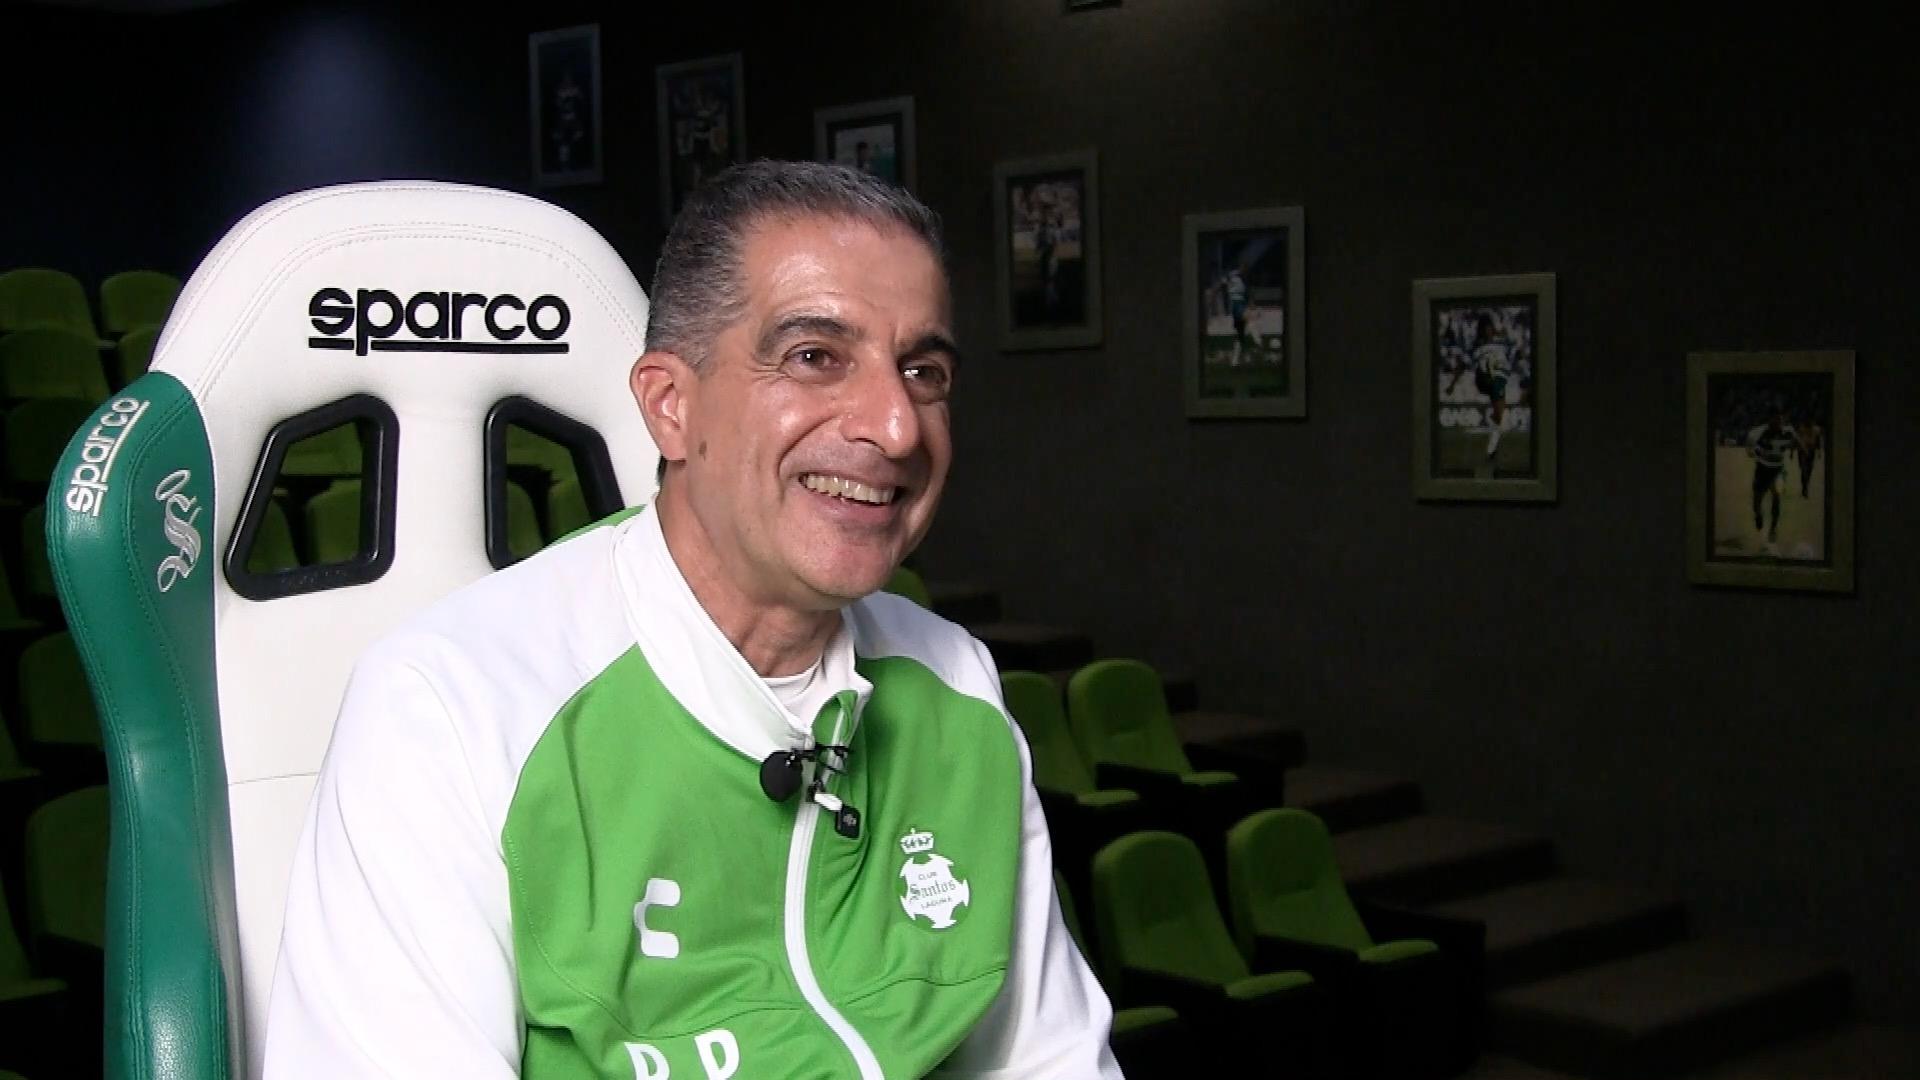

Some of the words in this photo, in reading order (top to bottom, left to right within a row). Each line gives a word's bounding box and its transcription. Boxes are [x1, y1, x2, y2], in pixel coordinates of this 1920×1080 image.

[308, 287, 571, 356] sparco
[66, 397, 148, 516] sparco
[909, 880, 957, 902] Santos
